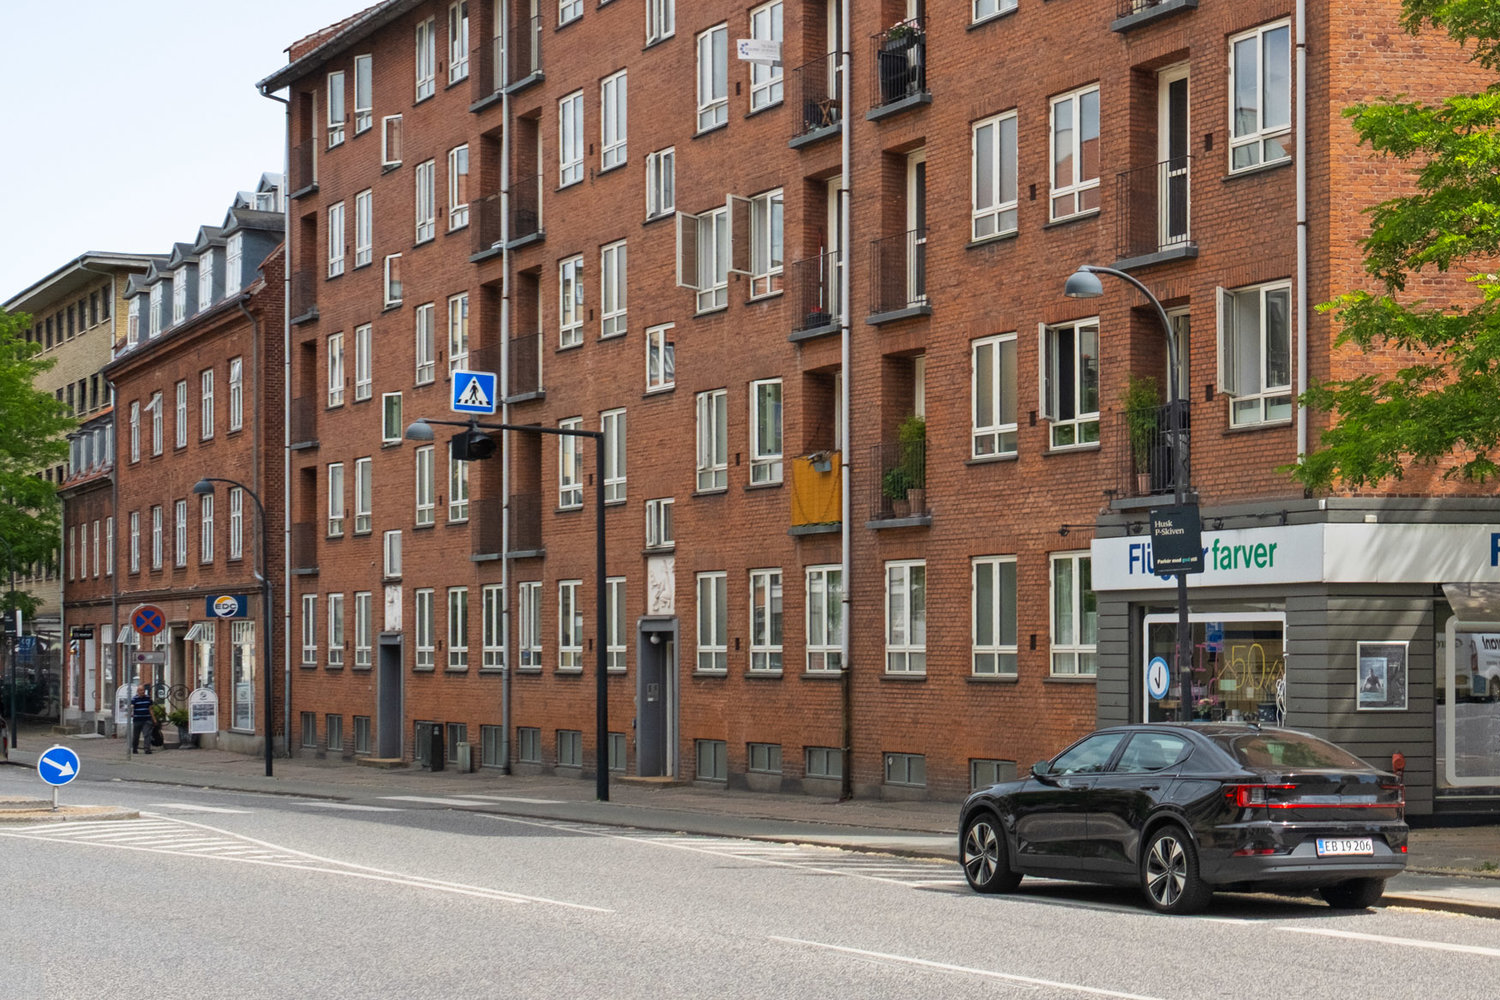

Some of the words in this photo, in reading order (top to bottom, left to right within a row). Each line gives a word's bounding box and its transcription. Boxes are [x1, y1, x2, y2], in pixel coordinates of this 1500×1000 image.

[1154, 519, 1173, 528] Husk
[1155, 528, 1185, 536] P-Skiven
[1212, 538, 1277, 570] farver
[1325, 840, 1338, 852] EB
[1341, 840, 1352, 851] 19
[1354, 840, 1372, 851] 206
